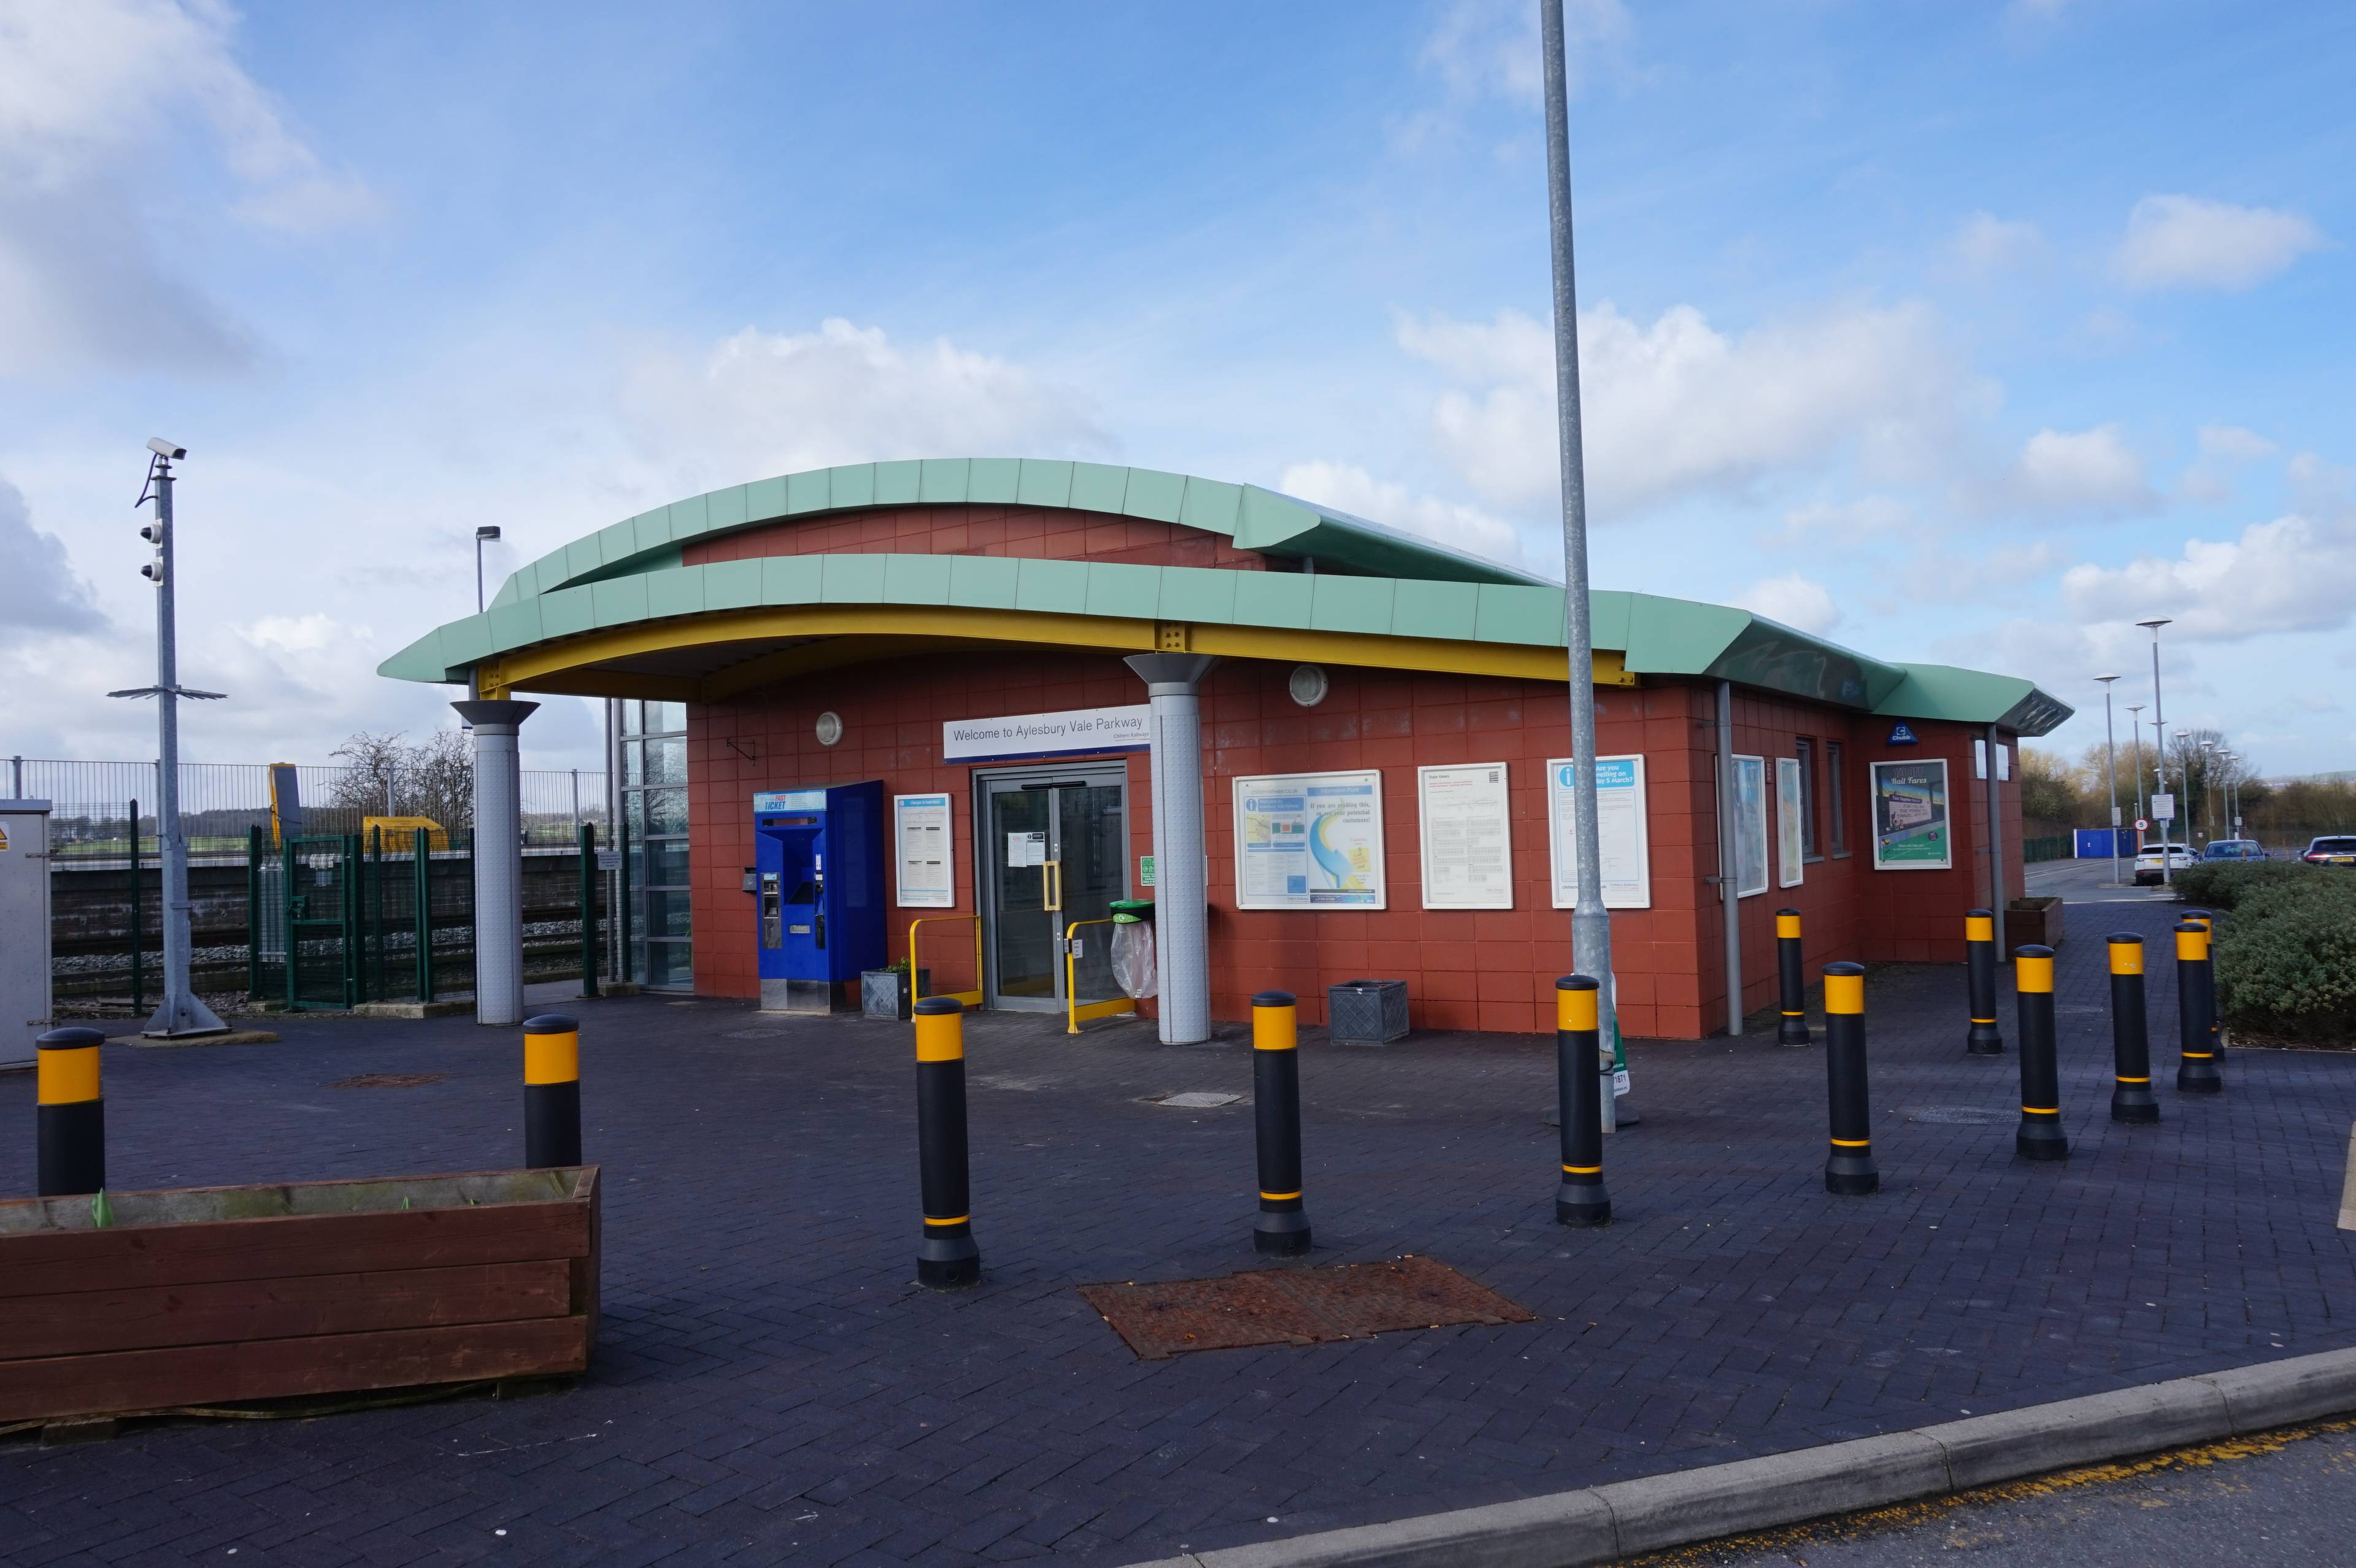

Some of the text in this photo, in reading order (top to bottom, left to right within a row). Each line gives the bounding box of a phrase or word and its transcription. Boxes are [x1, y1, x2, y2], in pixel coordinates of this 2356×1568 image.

[953, 717, 1142, 741] Welcome to Aylesbury Vale Parkway
[1908, 766, 1925, 777] OFF
[765, 801, 786, 810] TICKET
[1614, 1074, 1626, 1083] 1871
